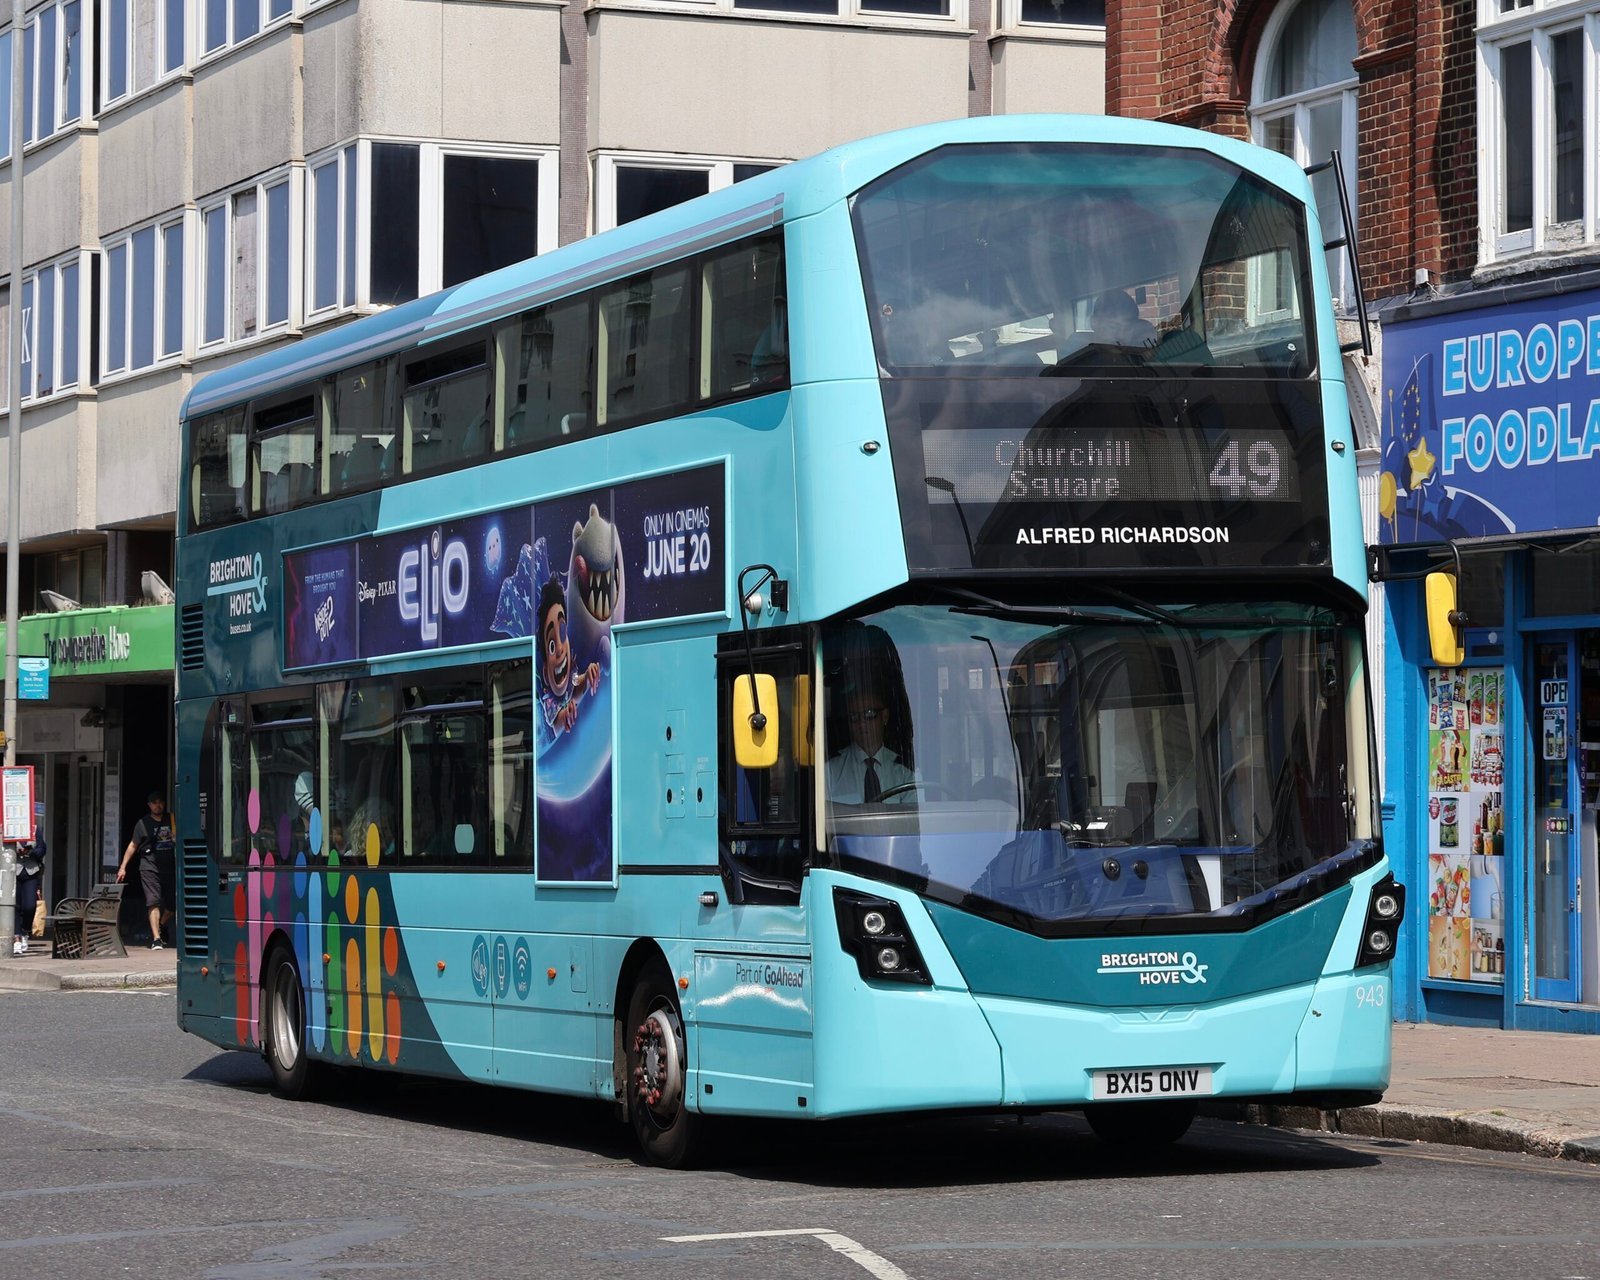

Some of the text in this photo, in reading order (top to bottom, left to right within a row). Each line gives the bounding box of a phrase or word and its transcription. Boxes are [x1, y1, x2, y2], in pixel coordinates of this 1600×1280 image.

[1442, 314, 1600, 396] EUROPE
[995, 440, 1280, 496] Churchill 49
[1010, 470, 1120, 496] Square
[643, 505, 710, 537] ONLY IN CINEMAS
[1016, 526, 1230, 544] ALFRED RICHARDSON
[643, 532, 711, 578] JUNE 20
[209, 554, 252, 584] BRIGHTON
[377, 580, 397, 597] PIXAR
[229, 592, 252, 617] HOVE
[1101, 952, 1178, 967] BRIGHTON
[735, 963, 804, 988] Part of GoAhead
[1140, 971, 1180, 985] HOVE
[1356, 984, 1385, 1009] 943
[1106, 1070, 1199, 1095] BX15 ONV
